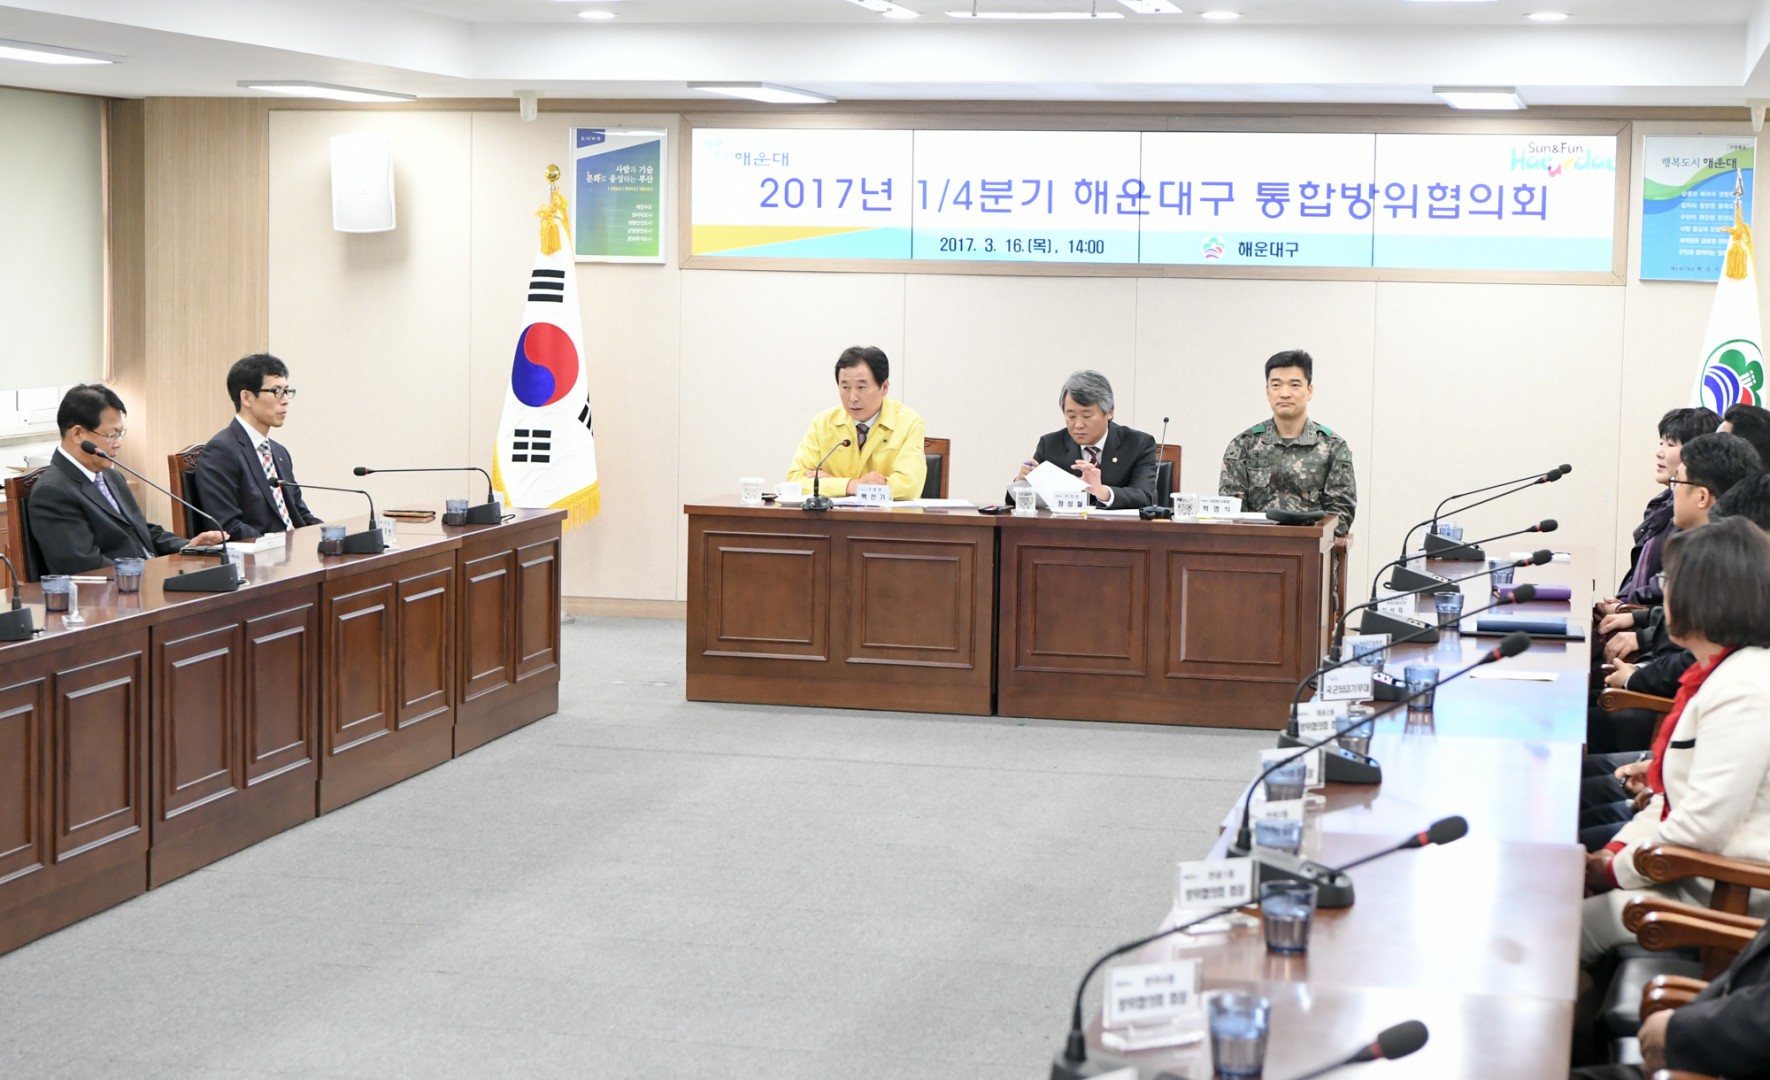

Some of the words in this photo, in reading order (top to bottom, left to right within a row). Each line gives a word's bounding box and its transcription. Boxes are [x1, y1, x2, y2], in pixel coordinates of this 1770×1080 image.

[1528, 141, 1583, 154] Sun&Fun
[734, 152, 789, 166] 해운대
[1662, 157, 1700, 168] 행복도시
[1703, 158, 1737, 169] 해운대
[616, 165, 637, 174] 사람과
[639, 165, 654, 174] 기술
[639, 174, 654, 183] 부산
[760, 177, 892, 211] 2017년
[917, 178, 1053, 214] 1/4분기
[1074, 179, 1234, 216] 해운대구
[1256, 181, 1546, 220] 통합방위협의회
[940, 237, 976, 252] 2017.
[985, 238, 996, 252] 3.
[1068, 239, 1104, 254] 14:00
[1238, 241, 1299, 257] 해운대구
